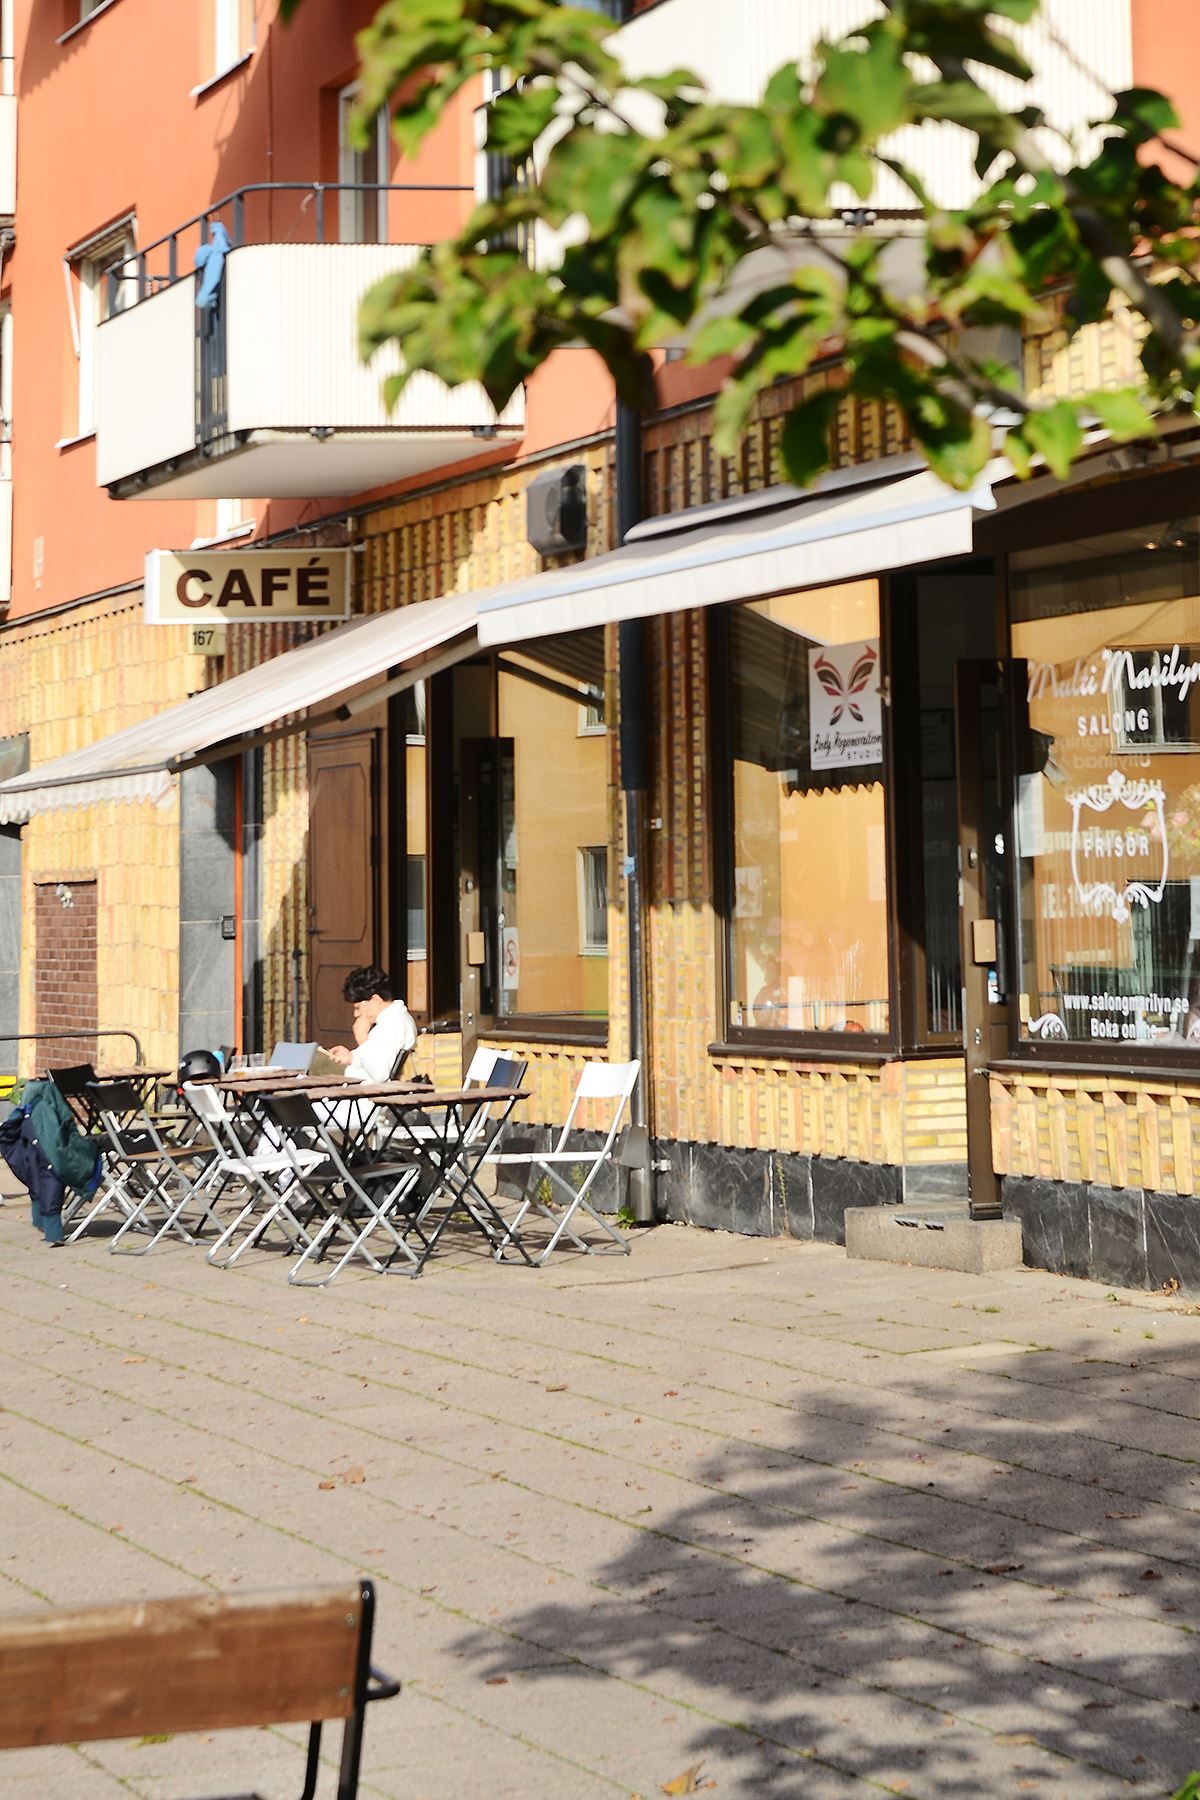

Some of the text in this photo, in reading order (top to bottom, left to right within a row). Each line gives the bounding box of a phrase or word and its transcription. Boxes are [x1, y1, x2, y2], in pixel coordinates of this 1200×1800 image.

[176, 557, 330, 608] CAFÉ
[193, 630, 215, 646] 167
[1077, 708, 1149, 737] SALONG
[1090, 1018, 1158, 1039] Boka onne
